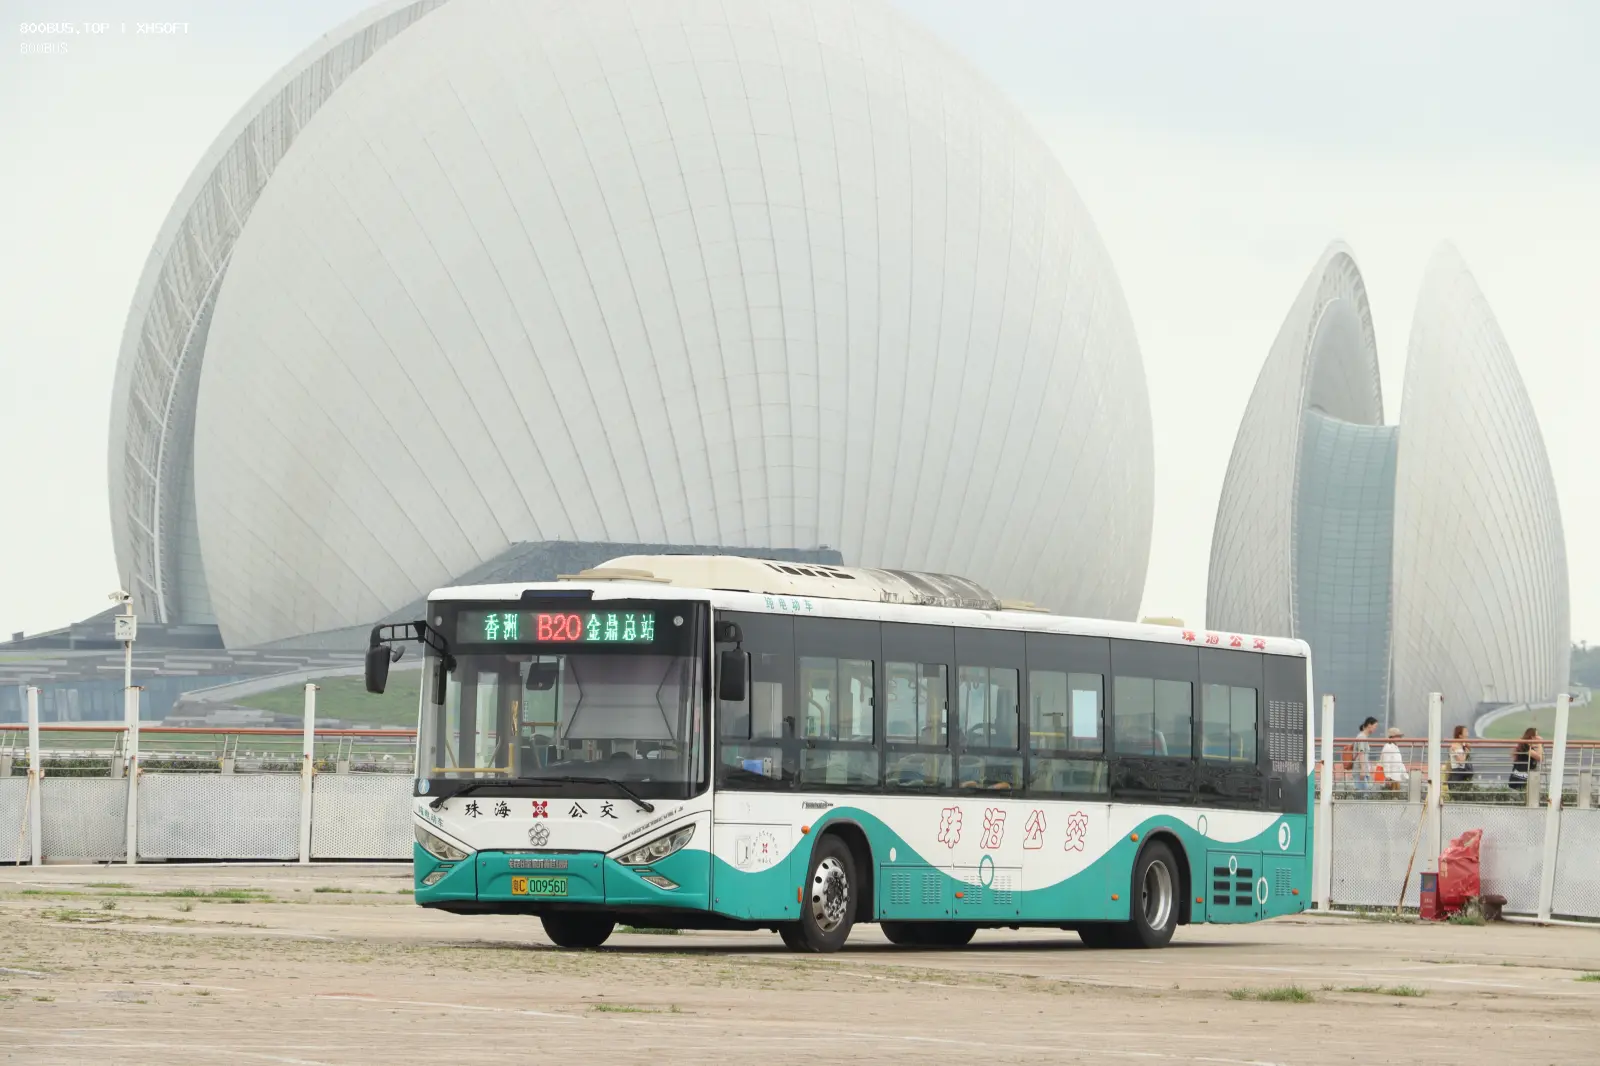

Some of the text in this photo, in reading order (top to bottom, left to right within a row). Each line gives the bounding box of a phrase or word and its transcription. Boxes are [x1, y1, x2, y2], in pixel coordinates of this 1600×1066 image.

[484, 613, 655, 641] 香洲 B20 金鼎总站
[1181, 630, 1267, 652] 珠海公交
[464, 800, 619, 820] 珠海 公交
[937, 805, 1089, 852] 珠海公交
